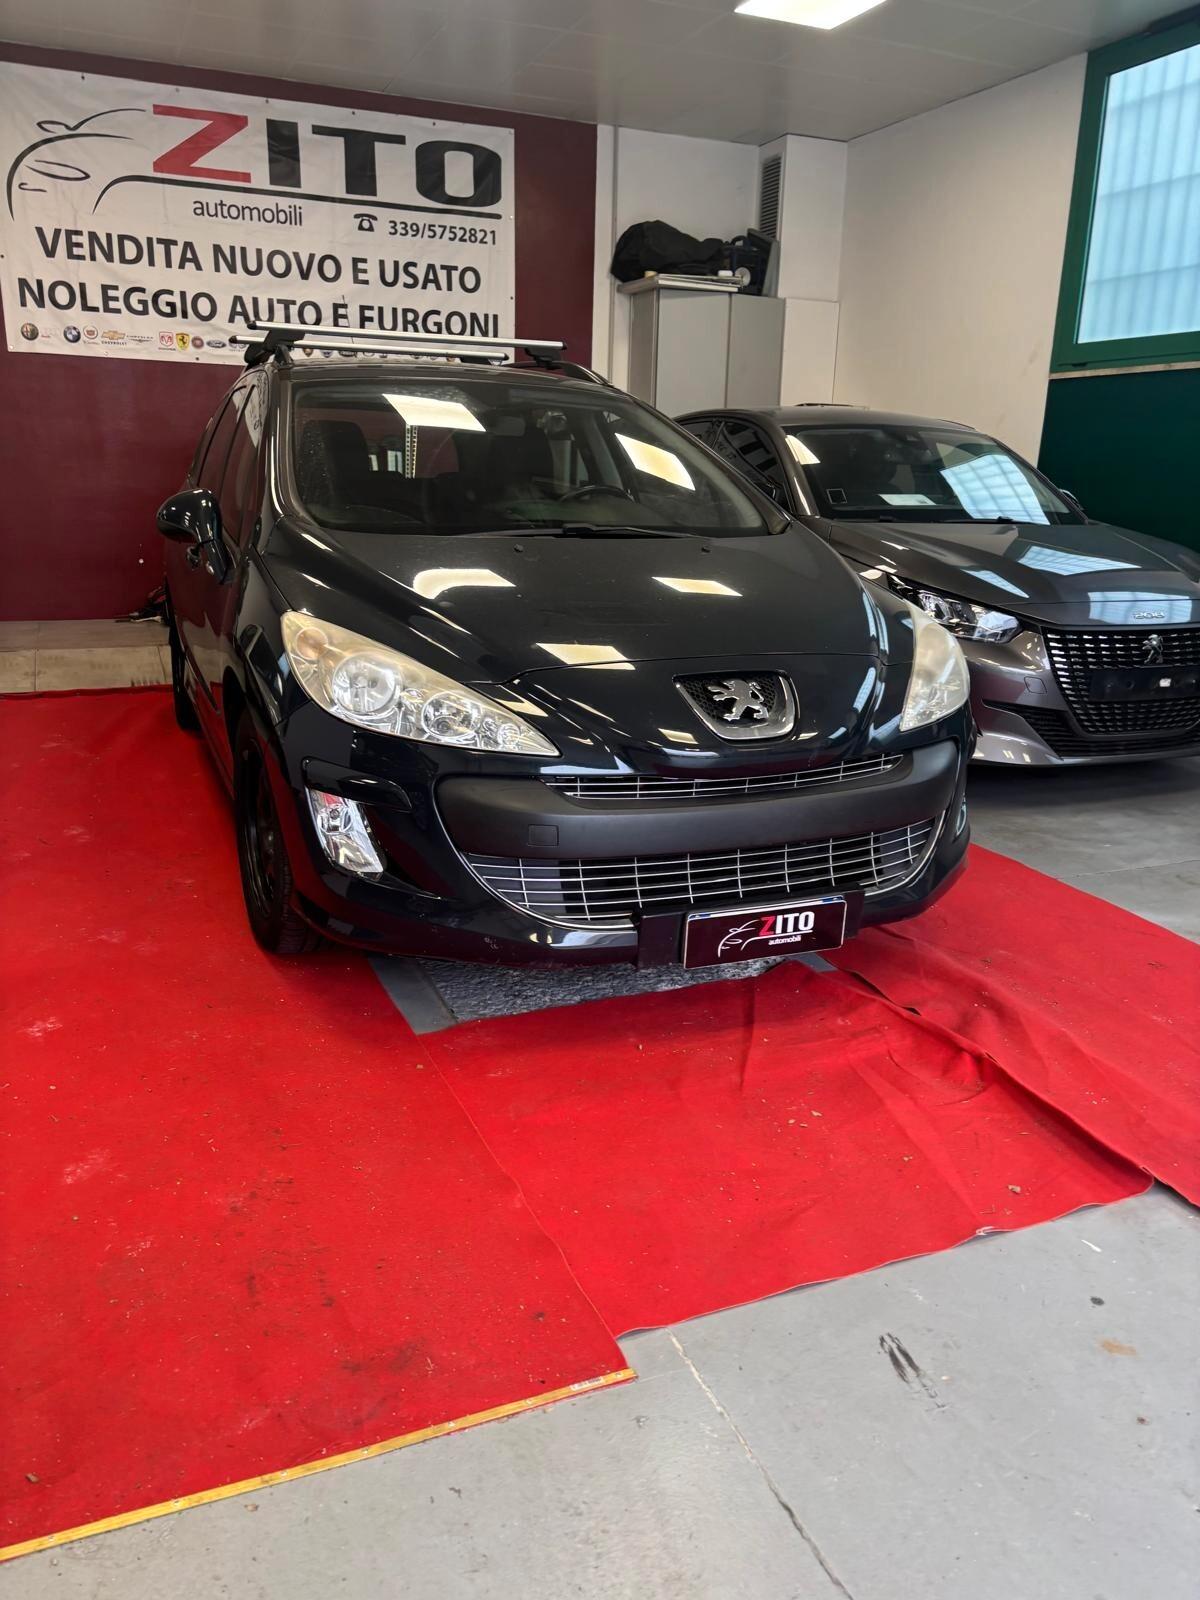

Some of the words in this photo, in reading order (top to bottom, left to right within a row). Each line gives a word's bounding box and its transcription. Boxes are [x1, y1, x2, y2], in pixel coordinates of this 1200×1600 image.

[152, 104, 503, 208] ZITO
[192, 198, 304, 227] automobili
[387, 219, 498, 246] 339/5752821
[35, 226, 205, 272] VENDITA
[212, 243, 342, 283] NUOVO
[351, 257, 371, 286] E
[378, 260, 482, 294] USATO
[17, 277, 218, 323] NOLEGGIO
[228, 294, 323, 328] AUTO
[332, 302, 349, 328] E
[358, 304, 499, 338] FURGONI
[759, 911, 815, 936] ZITO
[768, 935, 802, 946] automobili
